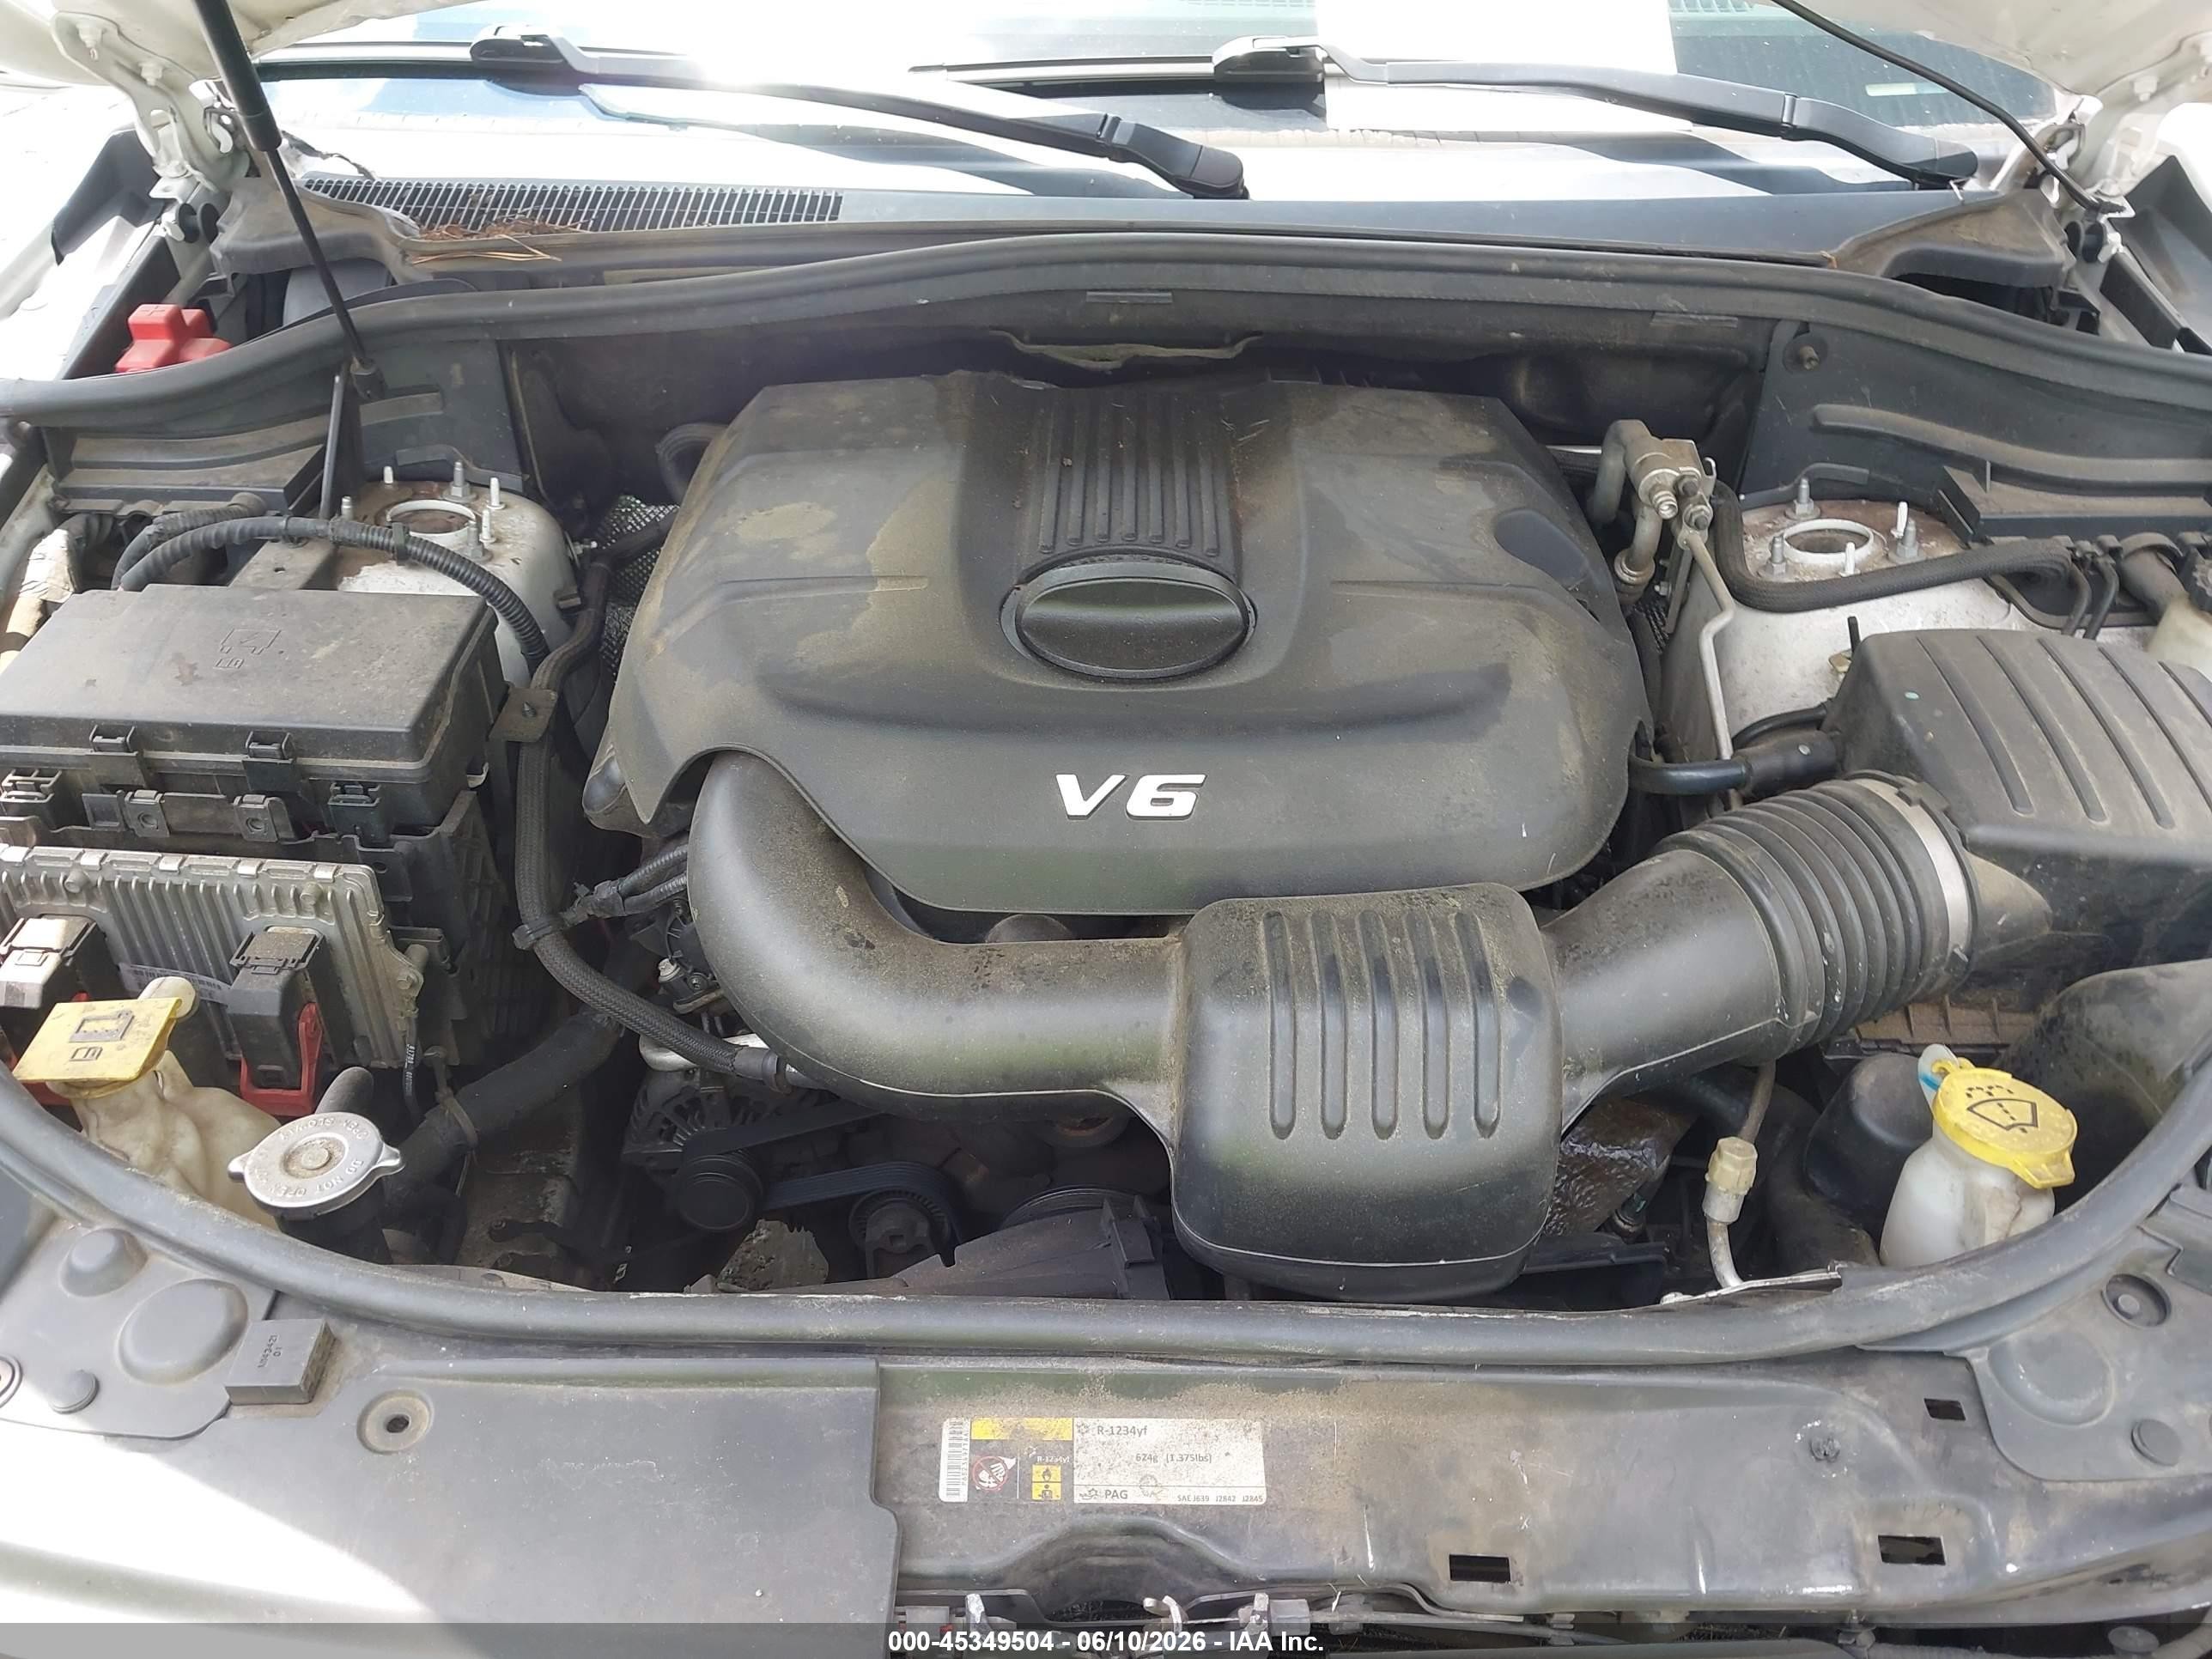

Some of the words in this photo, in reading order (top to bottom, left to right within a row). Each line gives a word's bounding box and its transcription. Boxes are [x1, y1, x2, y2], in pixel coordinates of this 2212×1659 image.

[1055, 774, 1207, 820] V6
[316, 1176, 343, 1191] NOT
[1097, 1425, 1147, 1437] R-1234yf
[1135, 1453, 1158, 1464] 624g
[1166, 1453, 1212, 1464] (1.375lbs)
[1104, 1489, 1128, 1499] PAG
